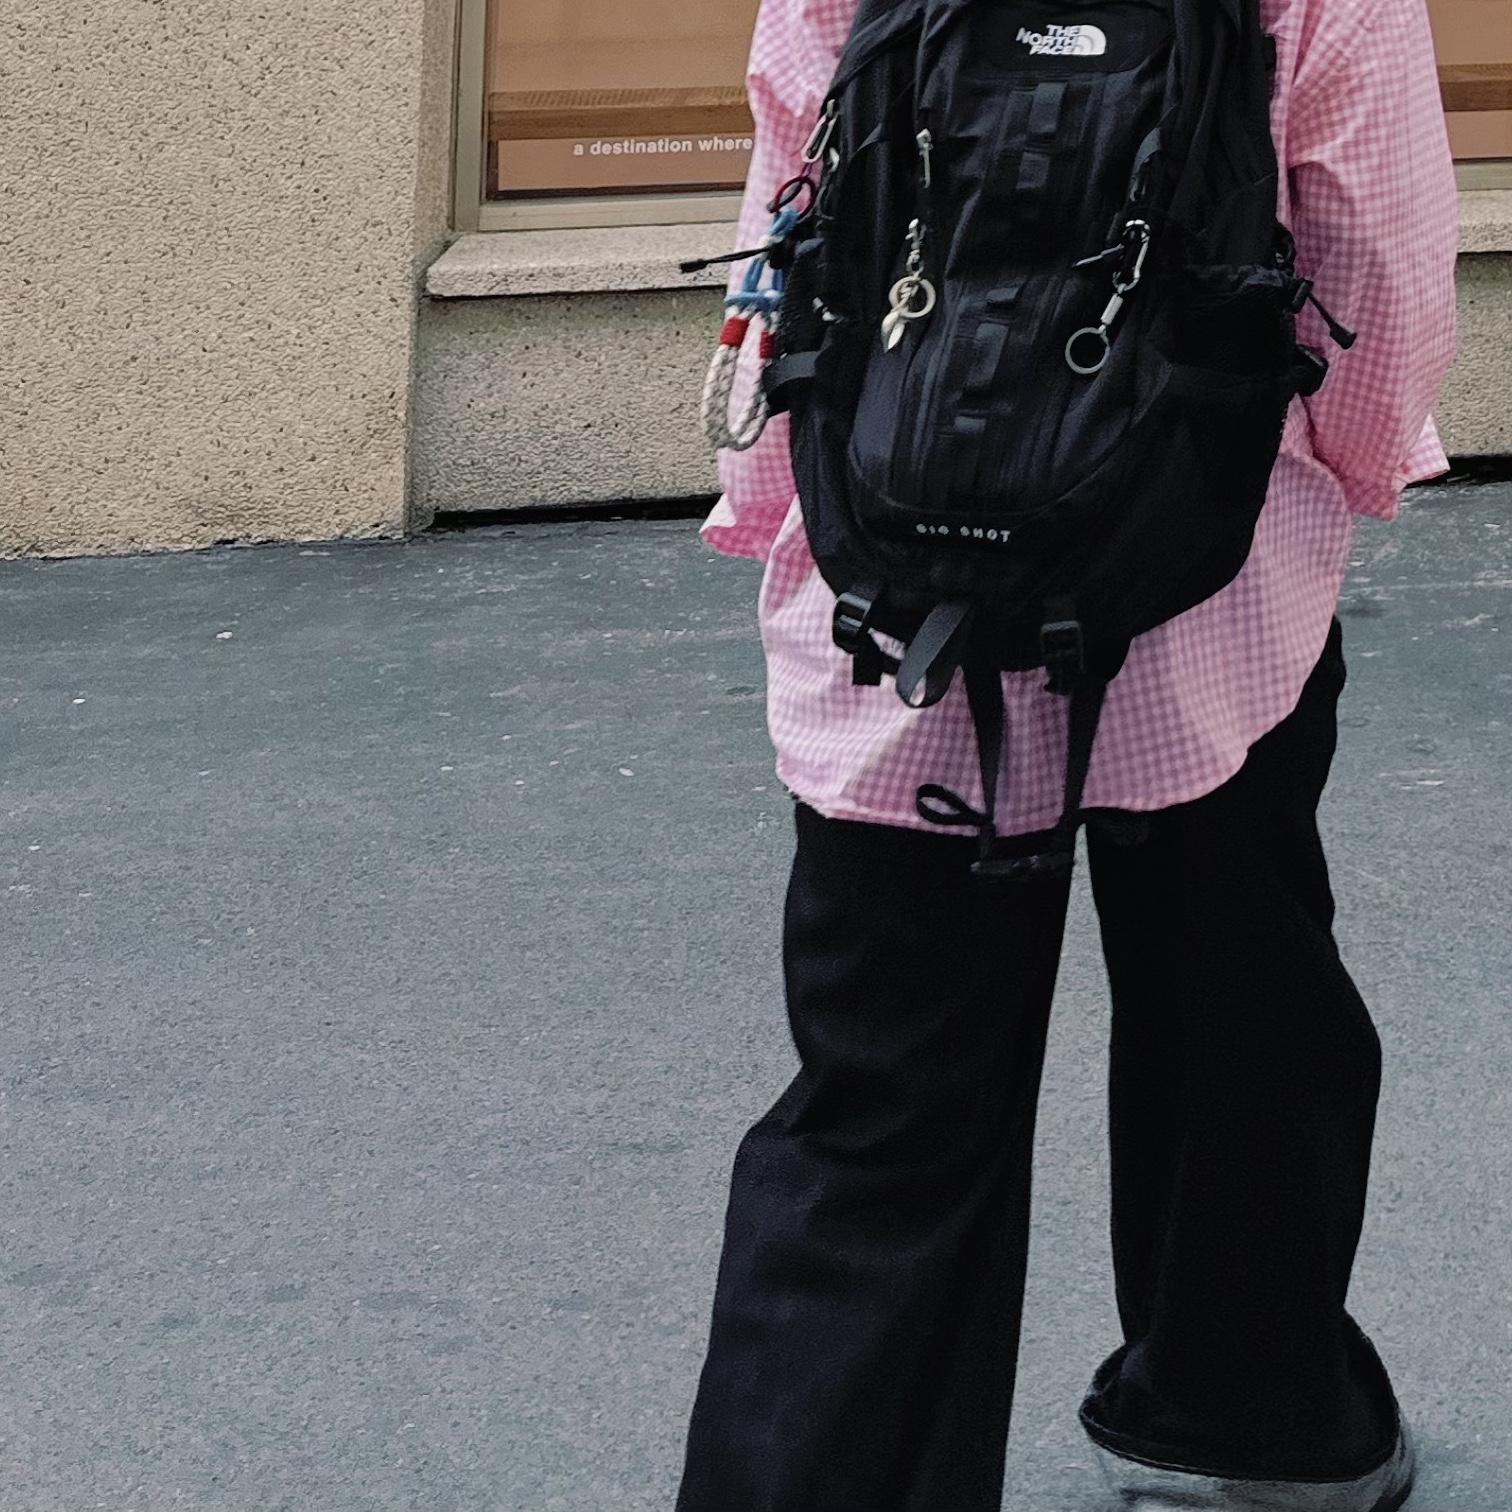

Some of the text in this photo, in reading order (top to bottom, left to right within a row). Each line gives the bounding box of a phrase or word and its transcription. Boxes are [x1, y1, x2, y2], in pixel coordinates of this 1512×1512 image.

[1015, 27, 1077, 47] NORTH
[1046, 24, 1080, 36] THE
[1029, 45, 1075, 56] FACE
[573, 136, 753, 155] a destination where
